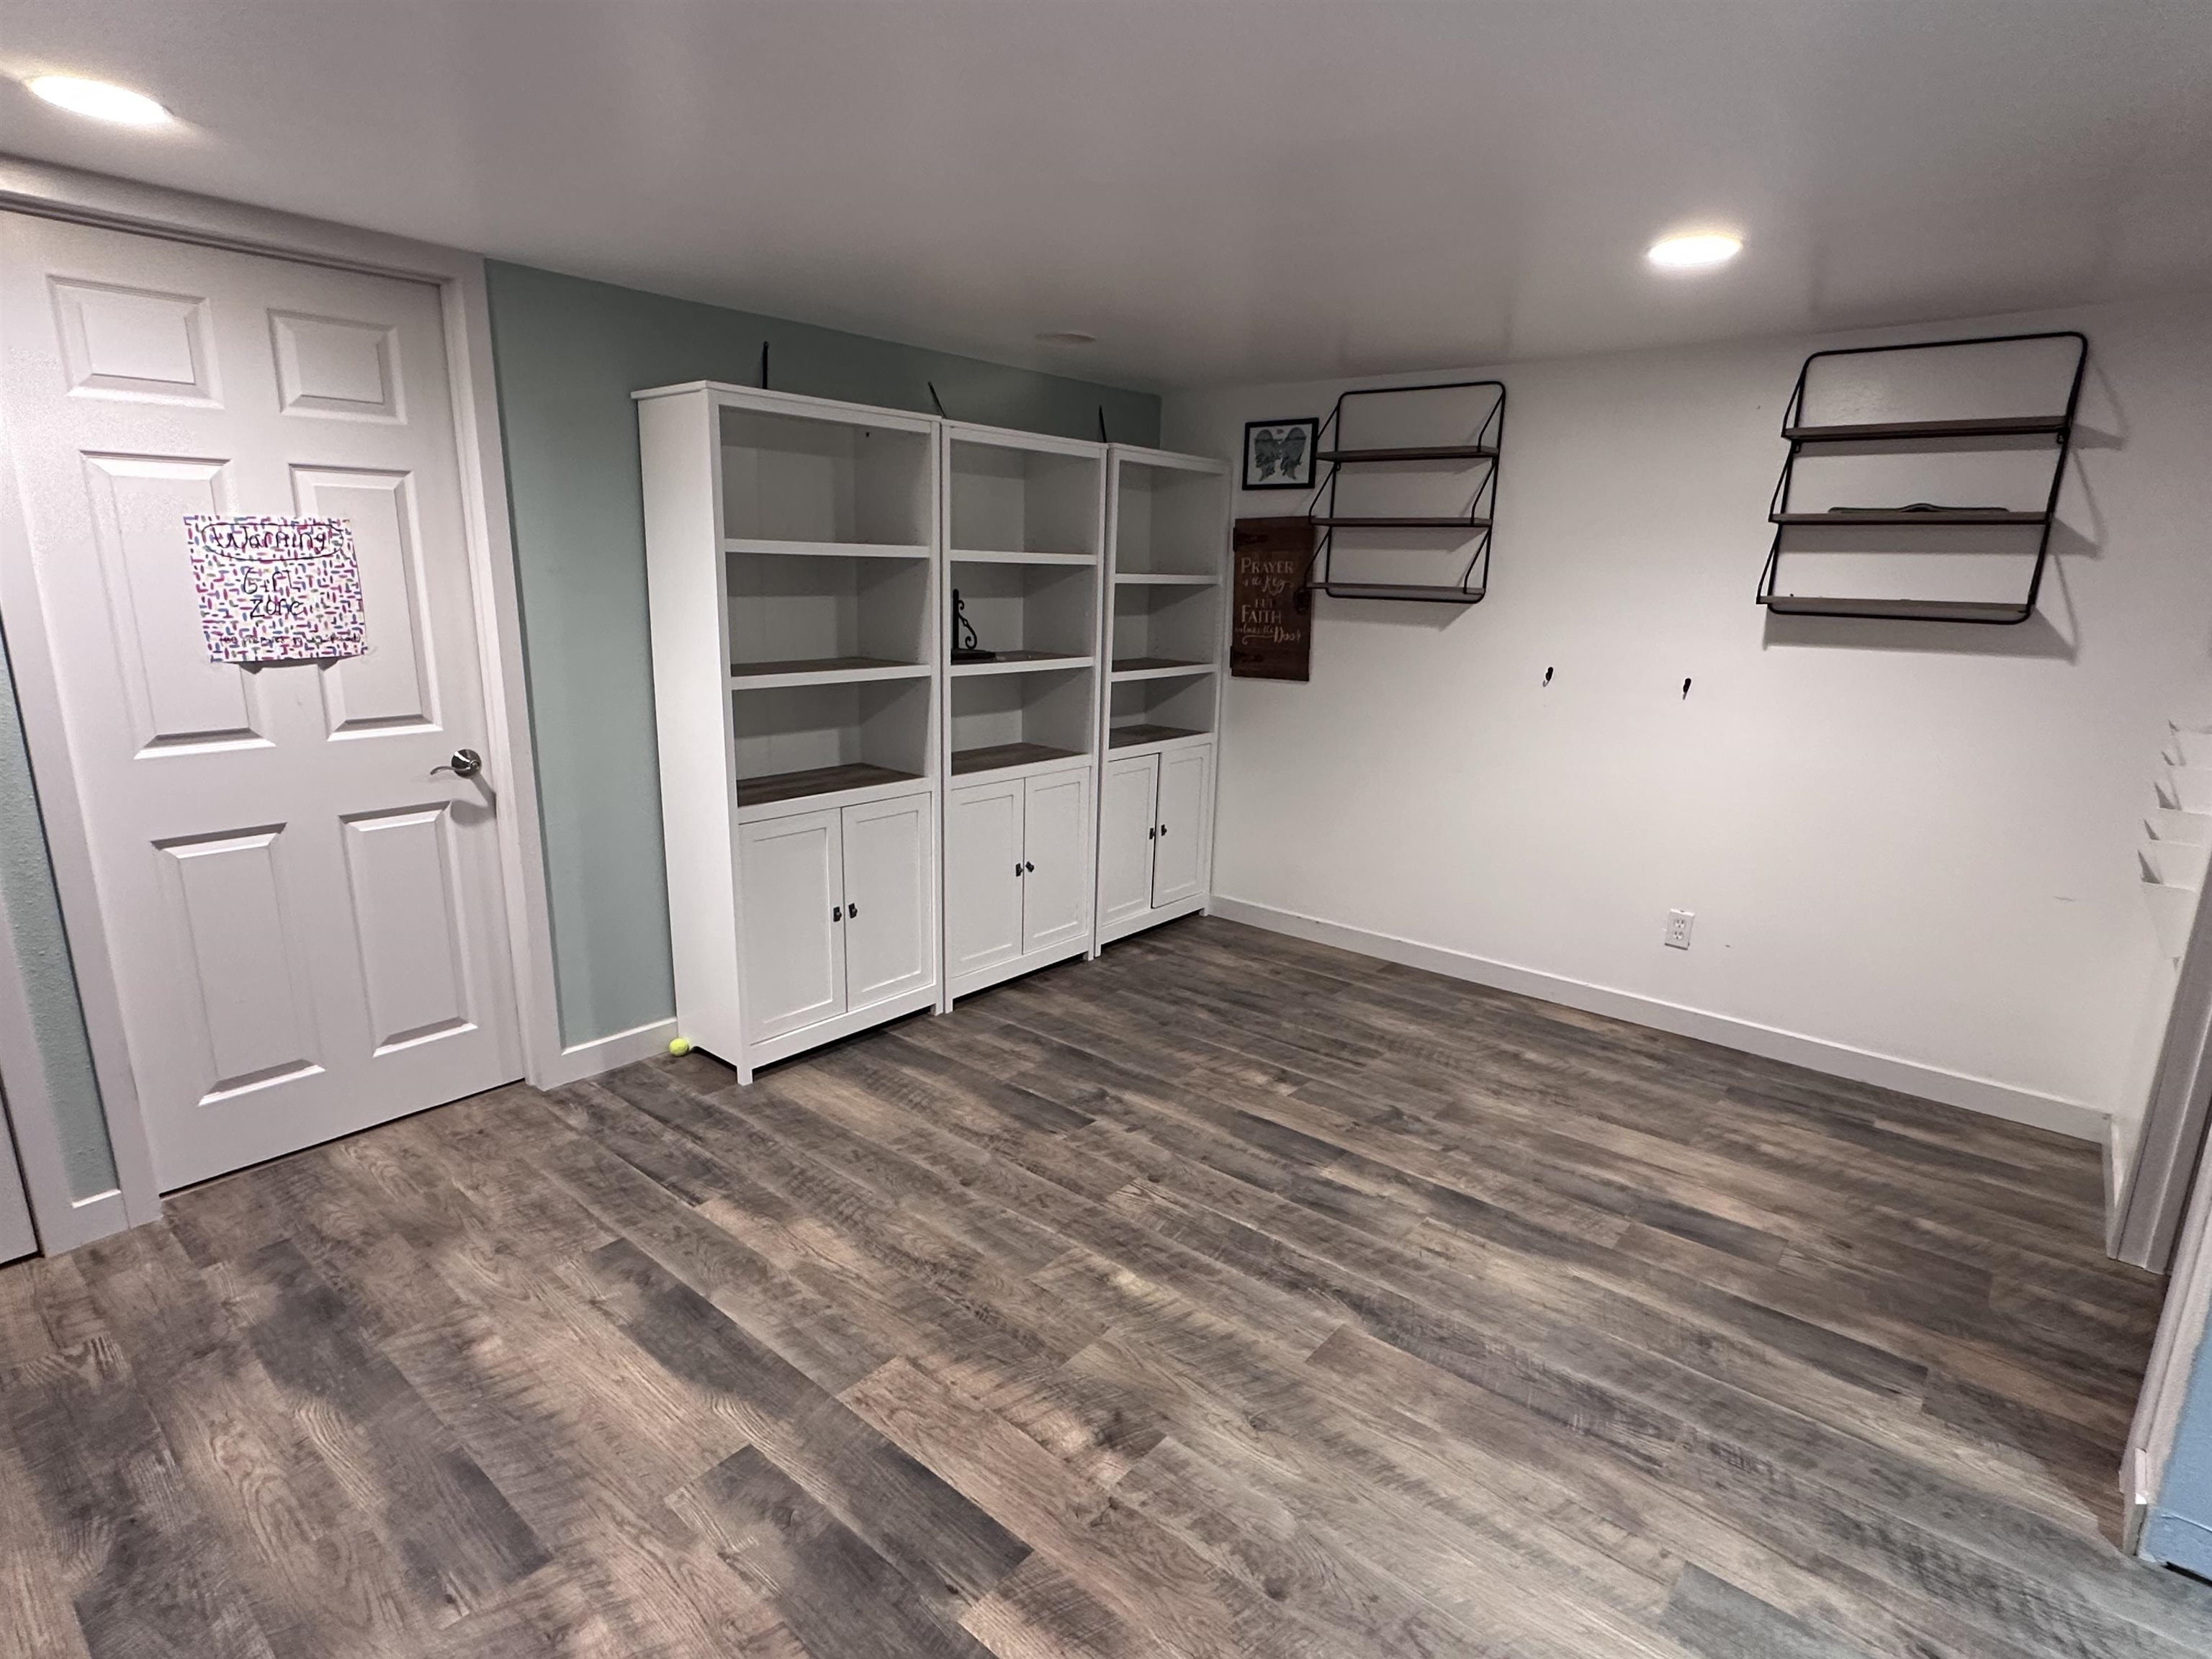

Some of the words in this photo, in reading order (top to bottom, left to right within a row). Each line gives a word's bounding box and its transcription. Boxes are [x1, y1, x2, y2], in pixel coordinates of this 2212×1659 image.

[212, 526, 325, 554] Warning
[1241, 557, 1294, 574] PRAYER
[1241, 605, 1282, 624] FAITH
